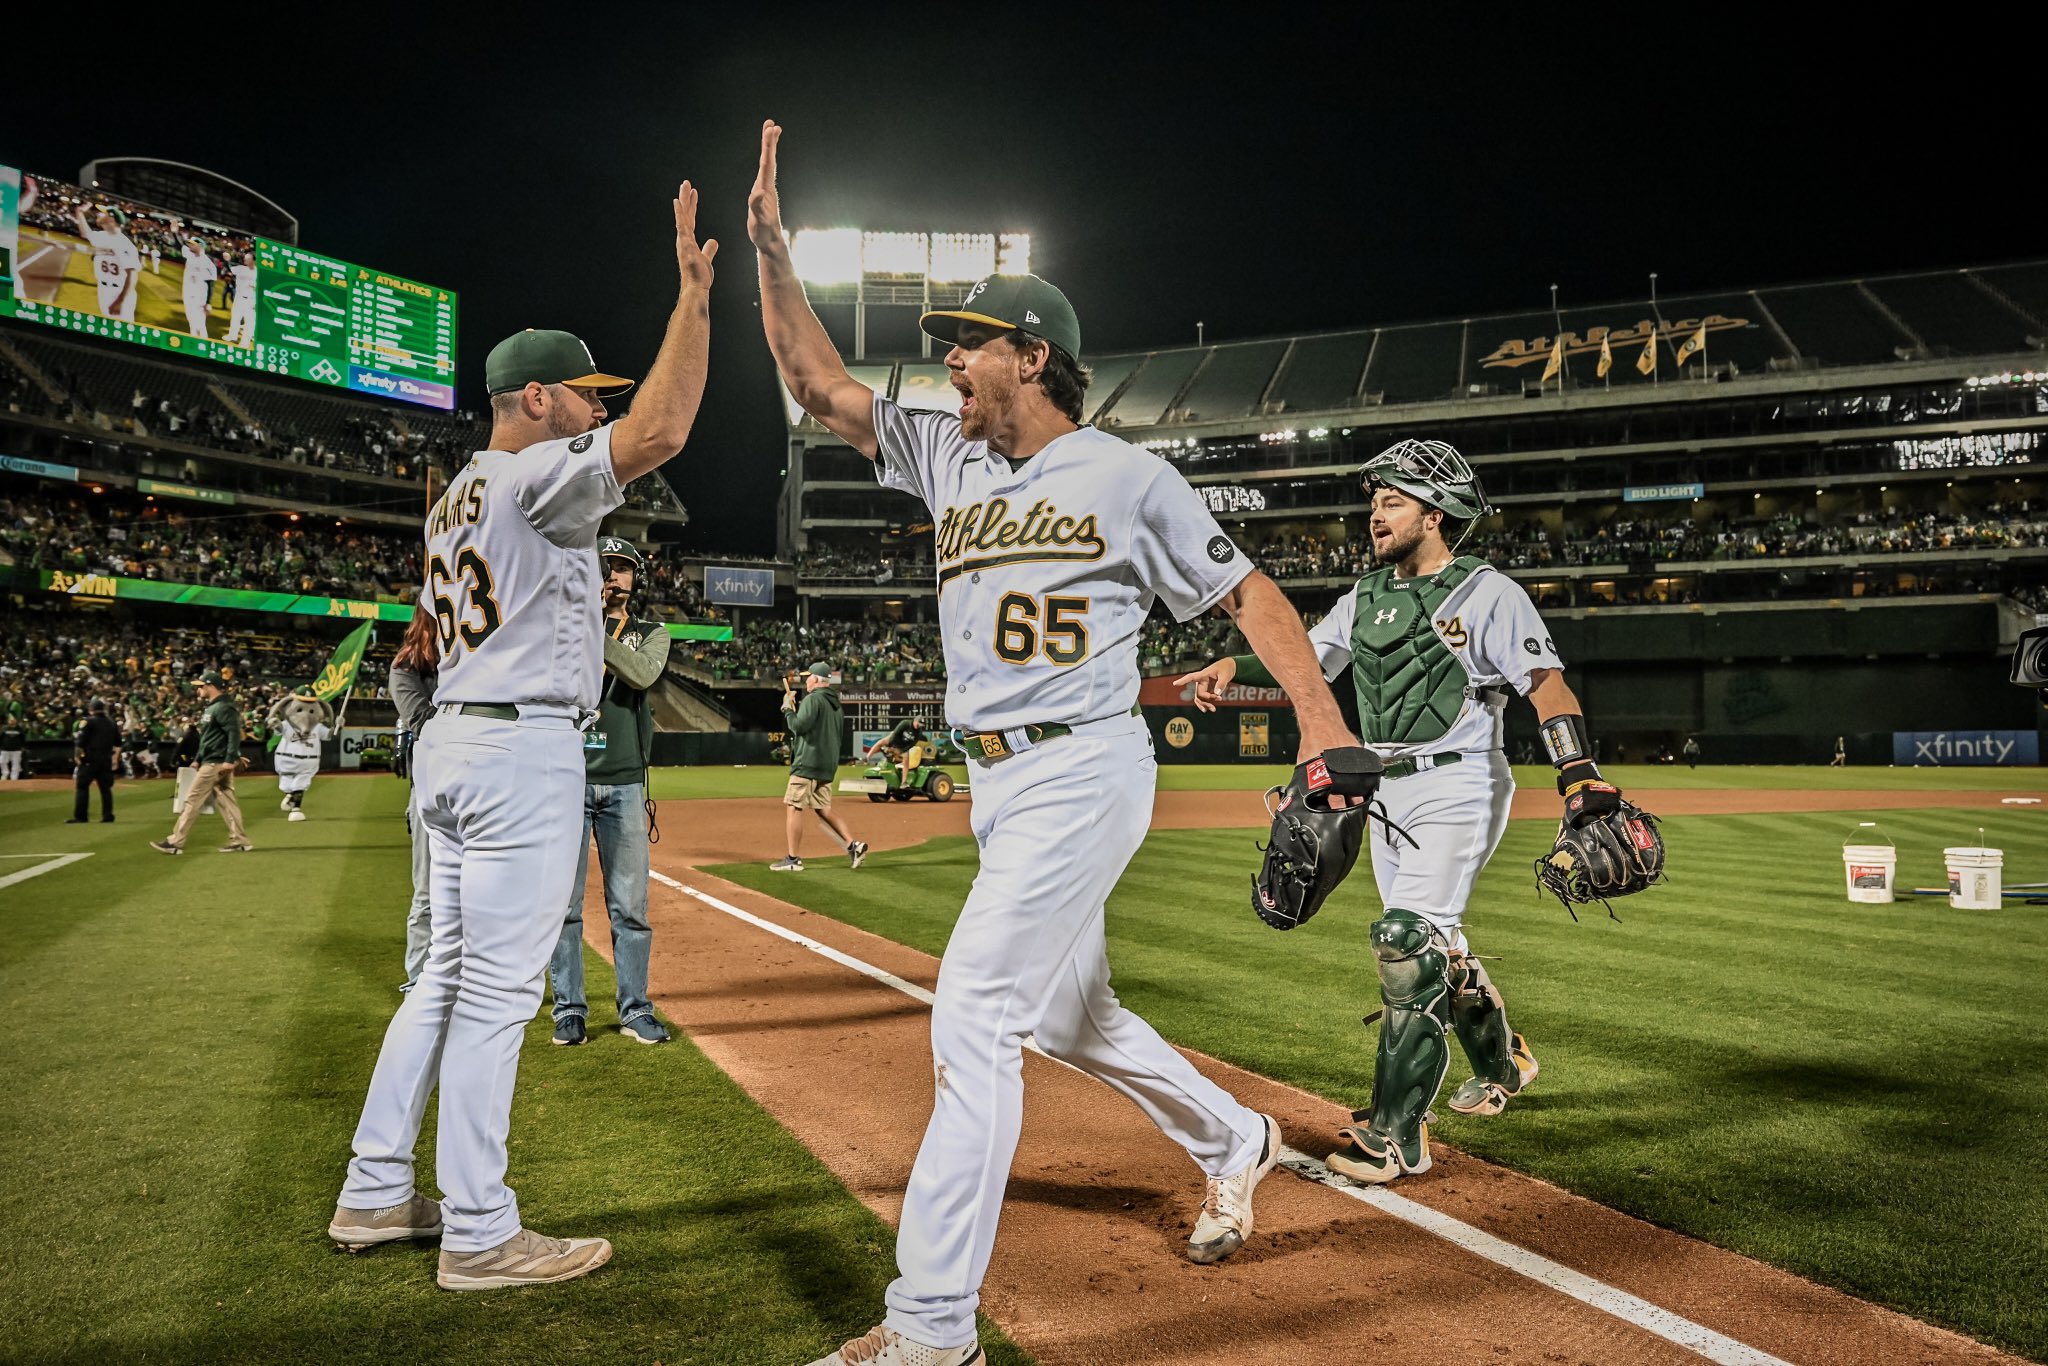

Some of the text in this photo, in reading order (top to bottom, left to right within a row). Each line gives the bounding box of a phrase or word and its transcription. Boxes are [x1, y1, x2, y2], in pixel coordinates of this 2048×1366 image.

[101, 260, 119, 275] 63
[376, 275, 432, 297] ATHLETICS
[1631, 486, 1696, 499] BUD LIGHT
[603, 538, 623, 552] A's
[1212, 541, 1231, 559] SAL
[74, 573, 117, 597] WIN
[714, 577, 764, 597] xfinity
[430, 546, 503, 656] 63
[347, 602, 380, 619] WIN
[993, 589, 1090, 666] 65
[840, 692, 867, 700] hanics
[869, 692, 890, 700] Bank
[907, 692, 934, 700] Where
[1170, 723, 1188, 734] RAY
[767, 732, 785, 742] 367
[984, 738, 1001, 754] 65
[1242, 745, 1266, 754] FIELD
[1915, 734, 2015, 763] xfinity
